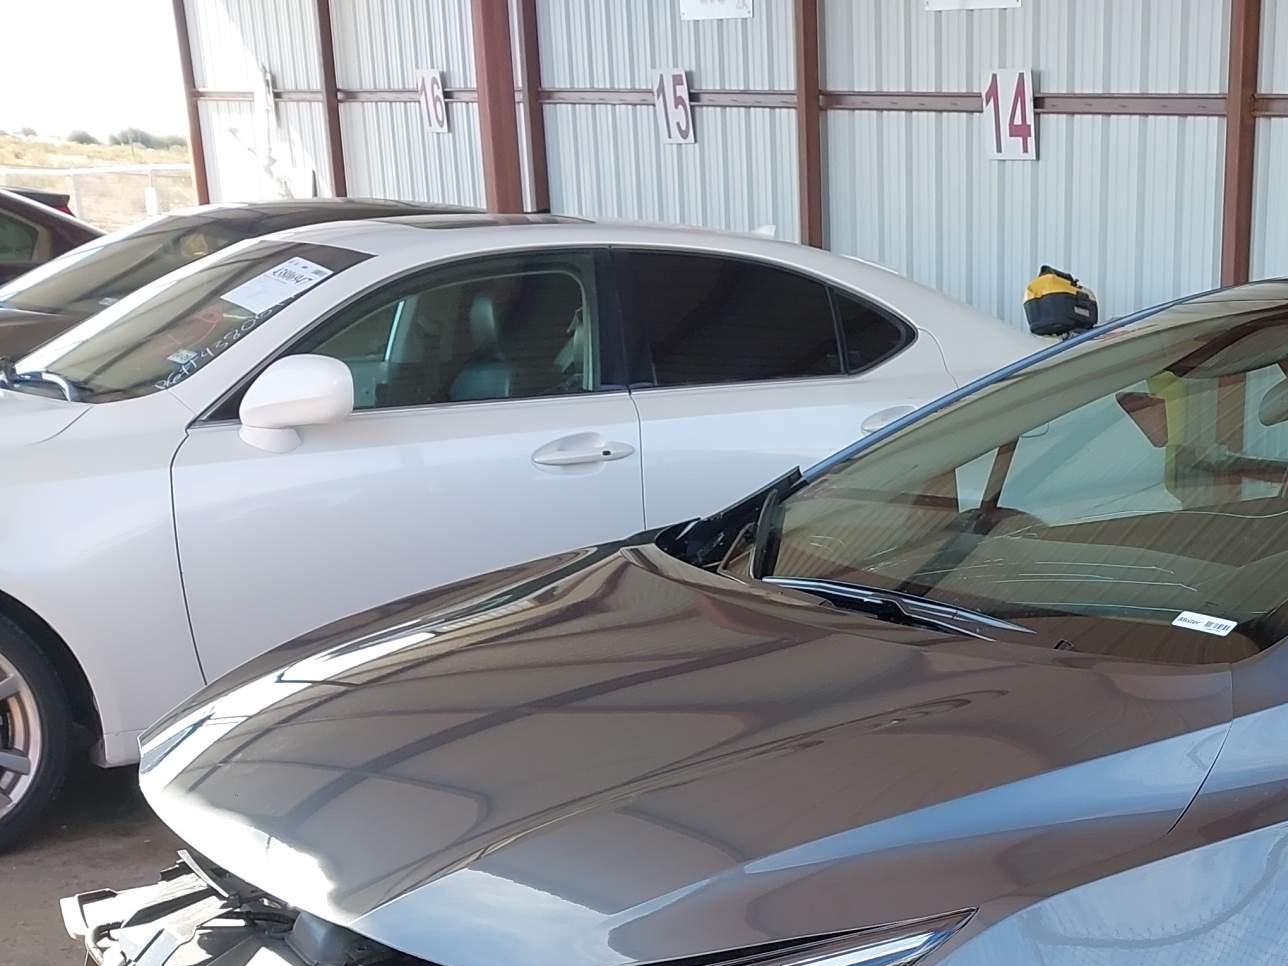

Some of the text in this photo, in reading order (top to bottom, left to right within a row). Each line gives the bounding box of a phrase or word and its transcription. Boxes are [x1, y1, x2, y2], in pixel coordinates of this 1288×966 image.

[419, 76, 445, 128] 16
[656, 73, 690, 139] 15
[985, 72, 1032, 153] 14
